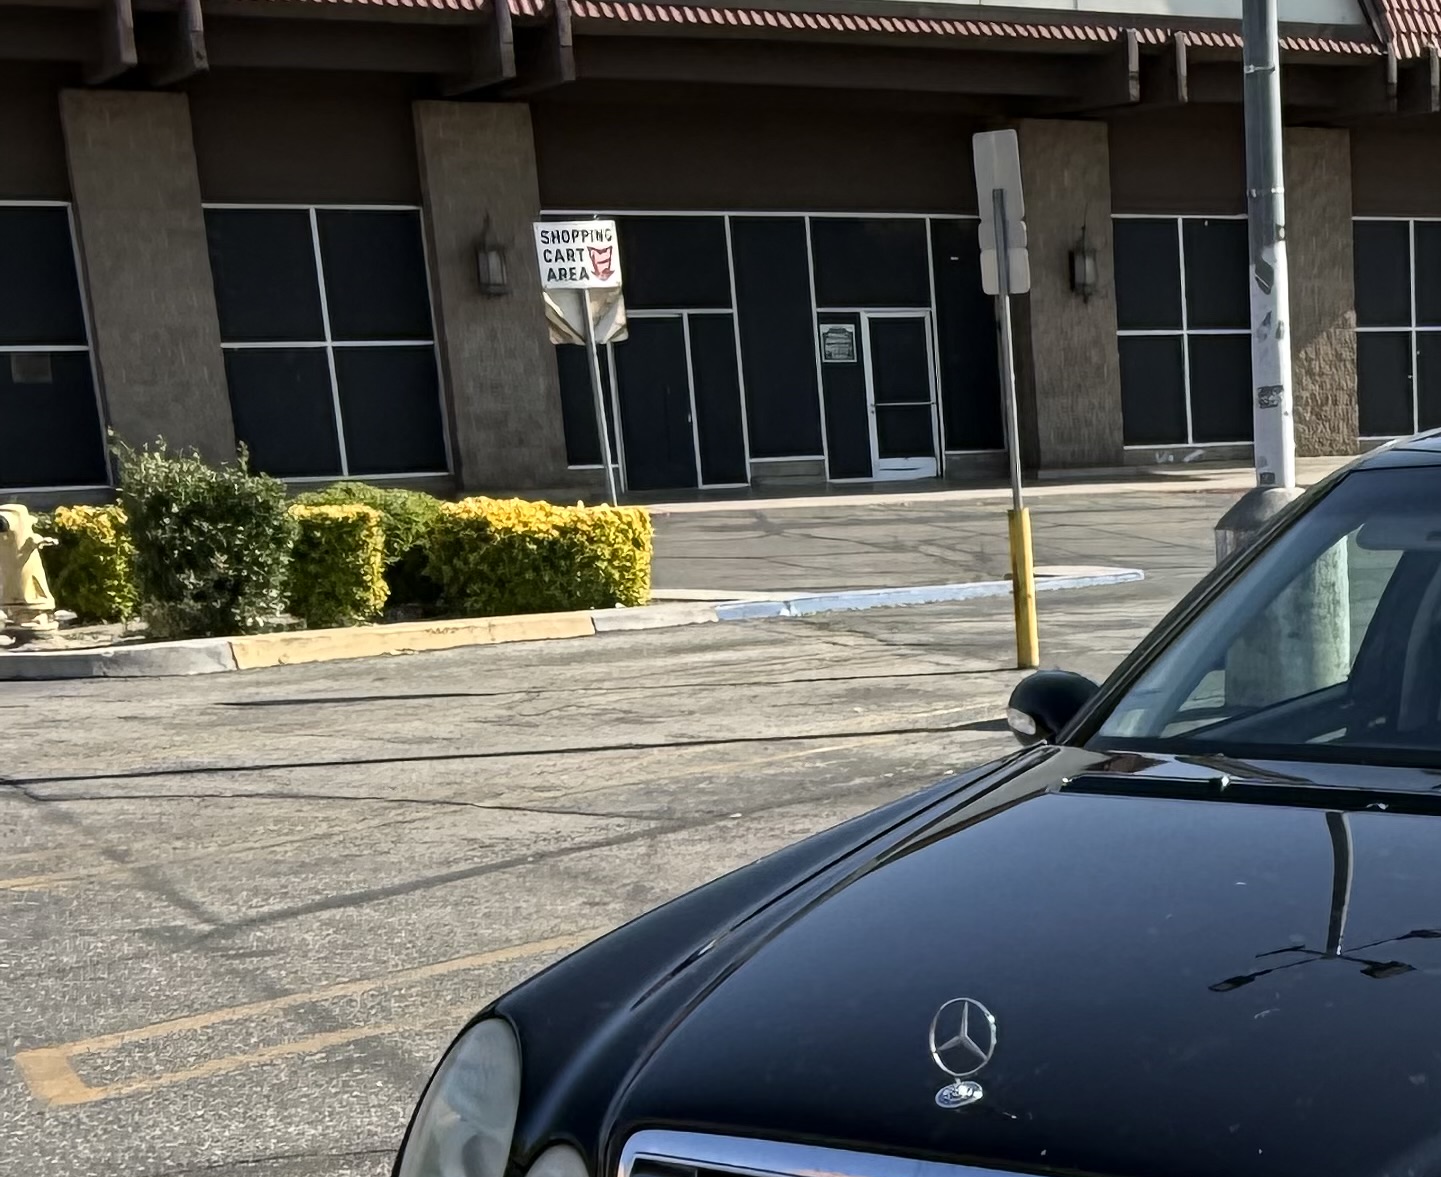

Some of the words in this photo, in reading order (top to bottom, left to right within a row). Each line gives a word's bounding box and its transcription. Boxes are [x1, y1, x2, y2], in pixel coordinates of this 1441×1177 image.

[541, 228, 612, 244] SHOPPING
[543, 248, 584, 263] CART
[547, 267, 590, 282] AREA
